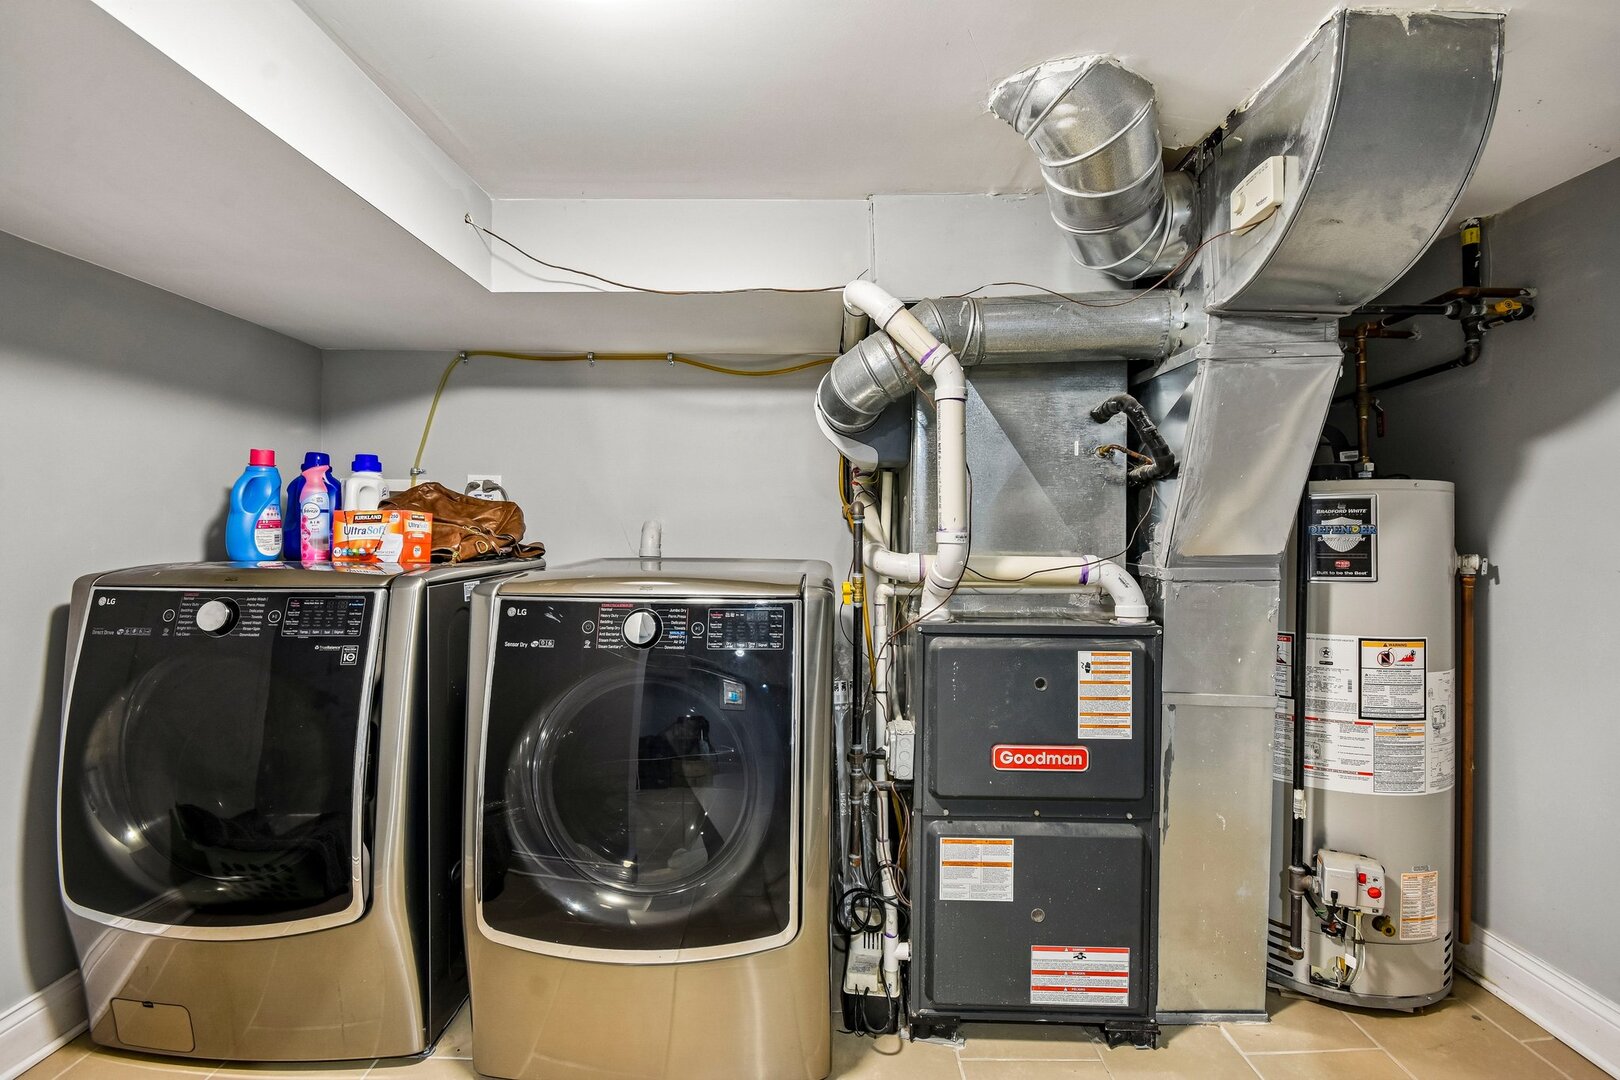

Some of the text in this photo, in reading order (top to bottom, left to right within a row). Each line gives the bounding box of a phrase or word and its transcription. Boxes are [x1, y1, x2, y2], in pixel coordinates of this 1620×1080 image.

[1308, 524, 1377, 536] DEFENDER
[107, 597, 116, 605] LG
[517, 608, 527, 616] LG
[519, 641, 529, 649] Dry
[999, 750, 1083, 767] Goodman
